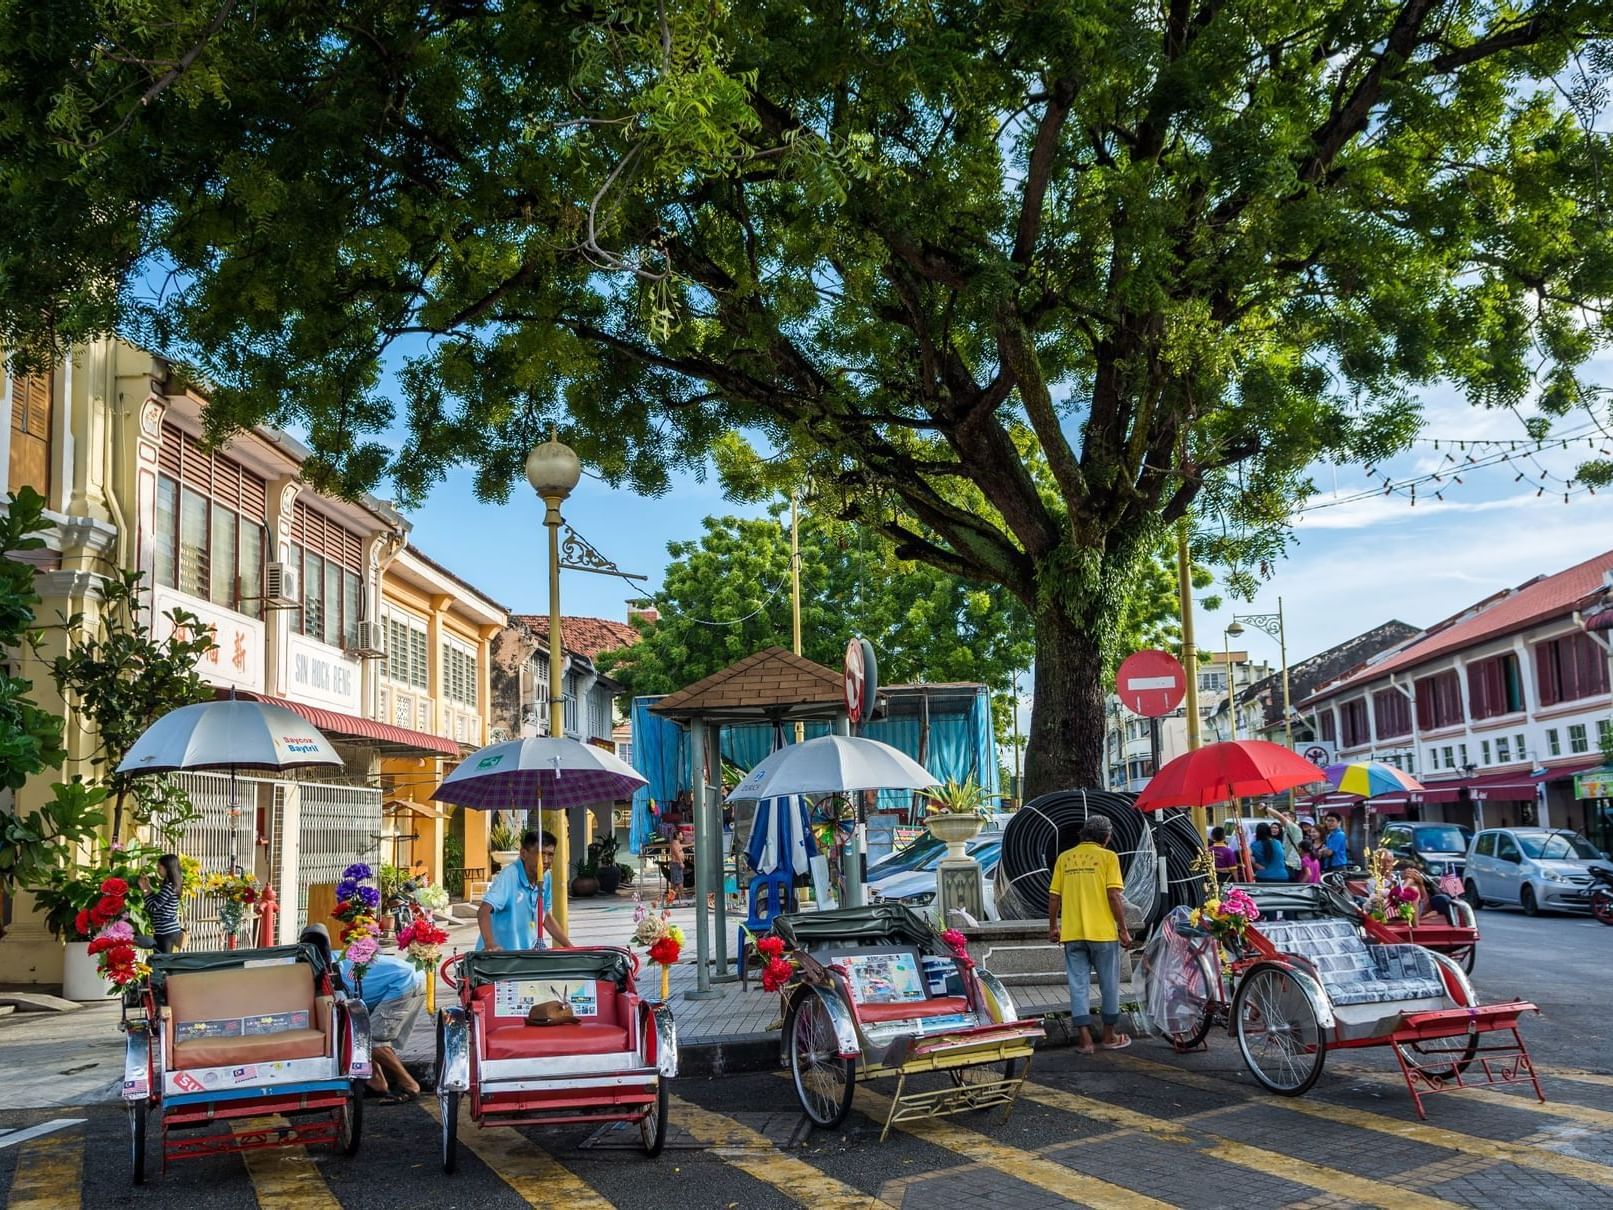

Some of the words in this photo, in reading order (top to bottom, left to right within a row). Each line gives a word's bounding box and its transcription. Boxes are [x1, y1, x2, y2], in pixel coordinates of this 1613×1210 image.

[295, 652, 308, 684] SIN
[312, 657, 330, 692] HOCK
[283, 736, 313, 744] Baycox
[288, 744, 319, 753] Baytril
